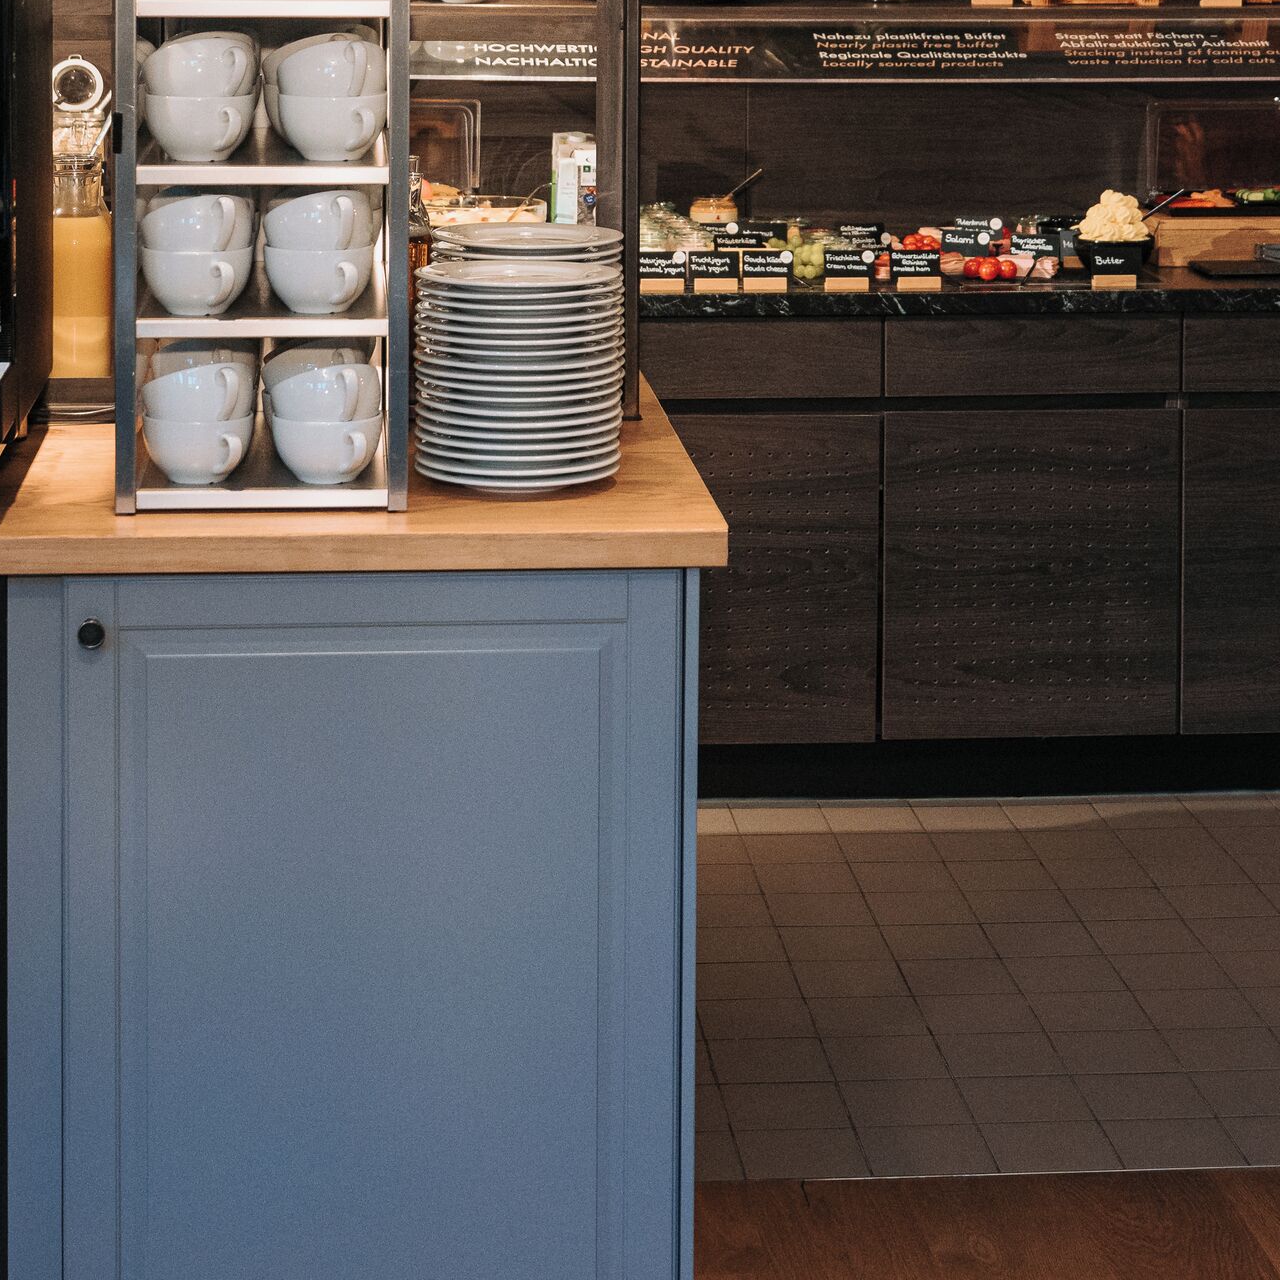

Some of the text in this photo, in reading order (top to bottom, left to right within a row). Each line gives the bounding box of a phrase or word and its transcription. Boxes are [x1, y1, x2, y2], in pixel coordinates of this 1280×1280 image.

[641, 32, 680, 40] NAL
[813, 32, 1006, 42] Nahezu plastikfreies Buffet
[1055, 32, 1109, 41] Stapeln
[1147, 32, 1204, 40] Fächern
[816, 41, 999, 50] Nearly plastic free buffet
[1059, 39, 1271, 48] Abfallreduktion bei Aufschnitt
[473, 43, 755, 54] HOCHWERTI GH QUALITY
[1063, 49, 1126, 58] Stacking
[1130, 49, 1183, 57] instead
[1206, 48, 1261, 57] fanning
[819, 51, 1028, 60] Regionale Qualitätsprodukte
[640, 58, 738, 68] STAINABLE
[822, 60, 1004, 69] Locally sourced products
[1114, 57, 1183, 65] reduction
[1187, 57, 1208, 65] for
[716, 237, 757, 245] Kräuterkäse
[945, 233, 975, 244] Salami
[743, 254, 766, 264] Gouda
[891, 252, 940, 260] Schwarzwälder
[1094, 255, 1125, 265] Butter
[901, 258, 928, 266] Schinken
[663, 266, 686, 275] yogurt
[707, 264, 729, 276] yogurt
[743, 264, 788, 273] Gouda cheese
[847, 263, 868, 271] cheese
